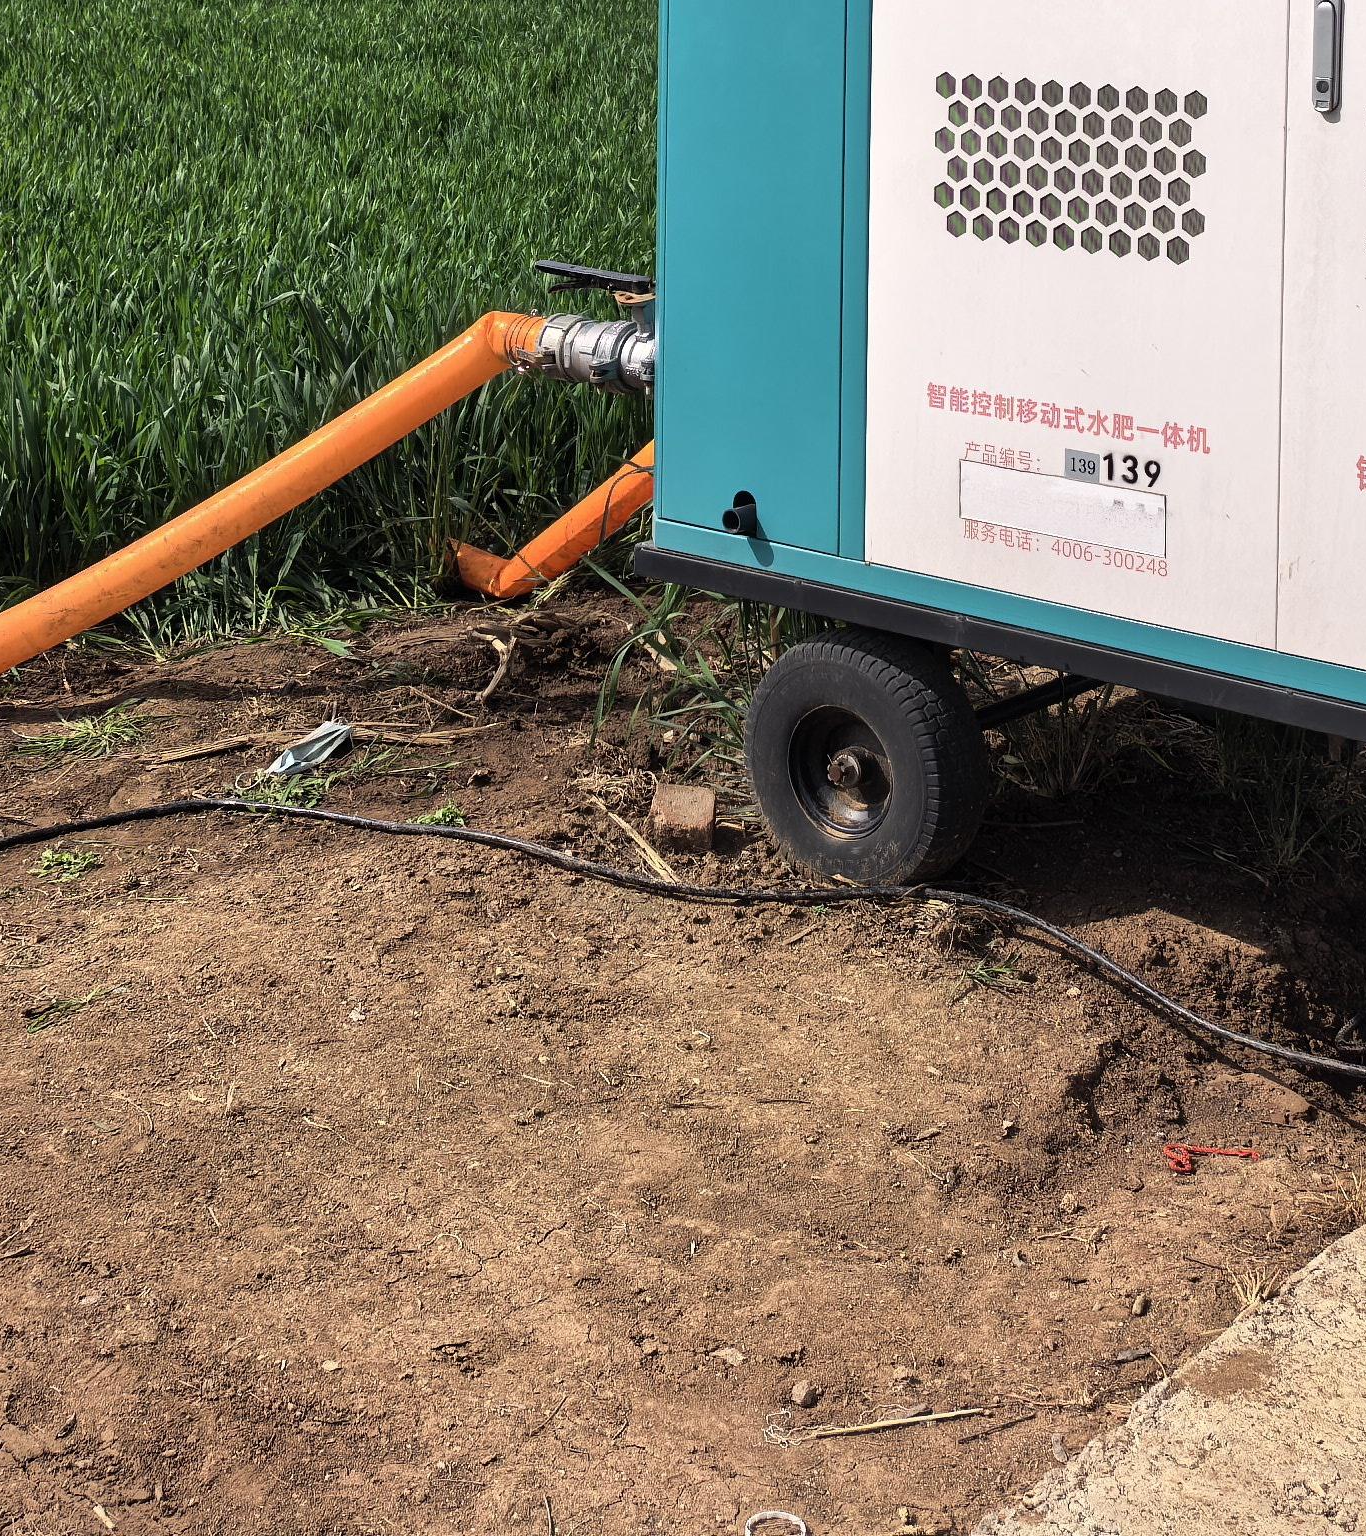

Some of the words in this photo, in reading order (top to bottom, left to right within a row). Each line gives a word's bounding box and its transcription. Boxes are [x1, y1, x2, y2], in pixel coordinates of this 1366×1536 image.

[926, 381, 1211, 455] 智能控制移动式水肥一体机
[1069, 457, 1097, 475] 139
[1103, 452, 1162, 489] 139
